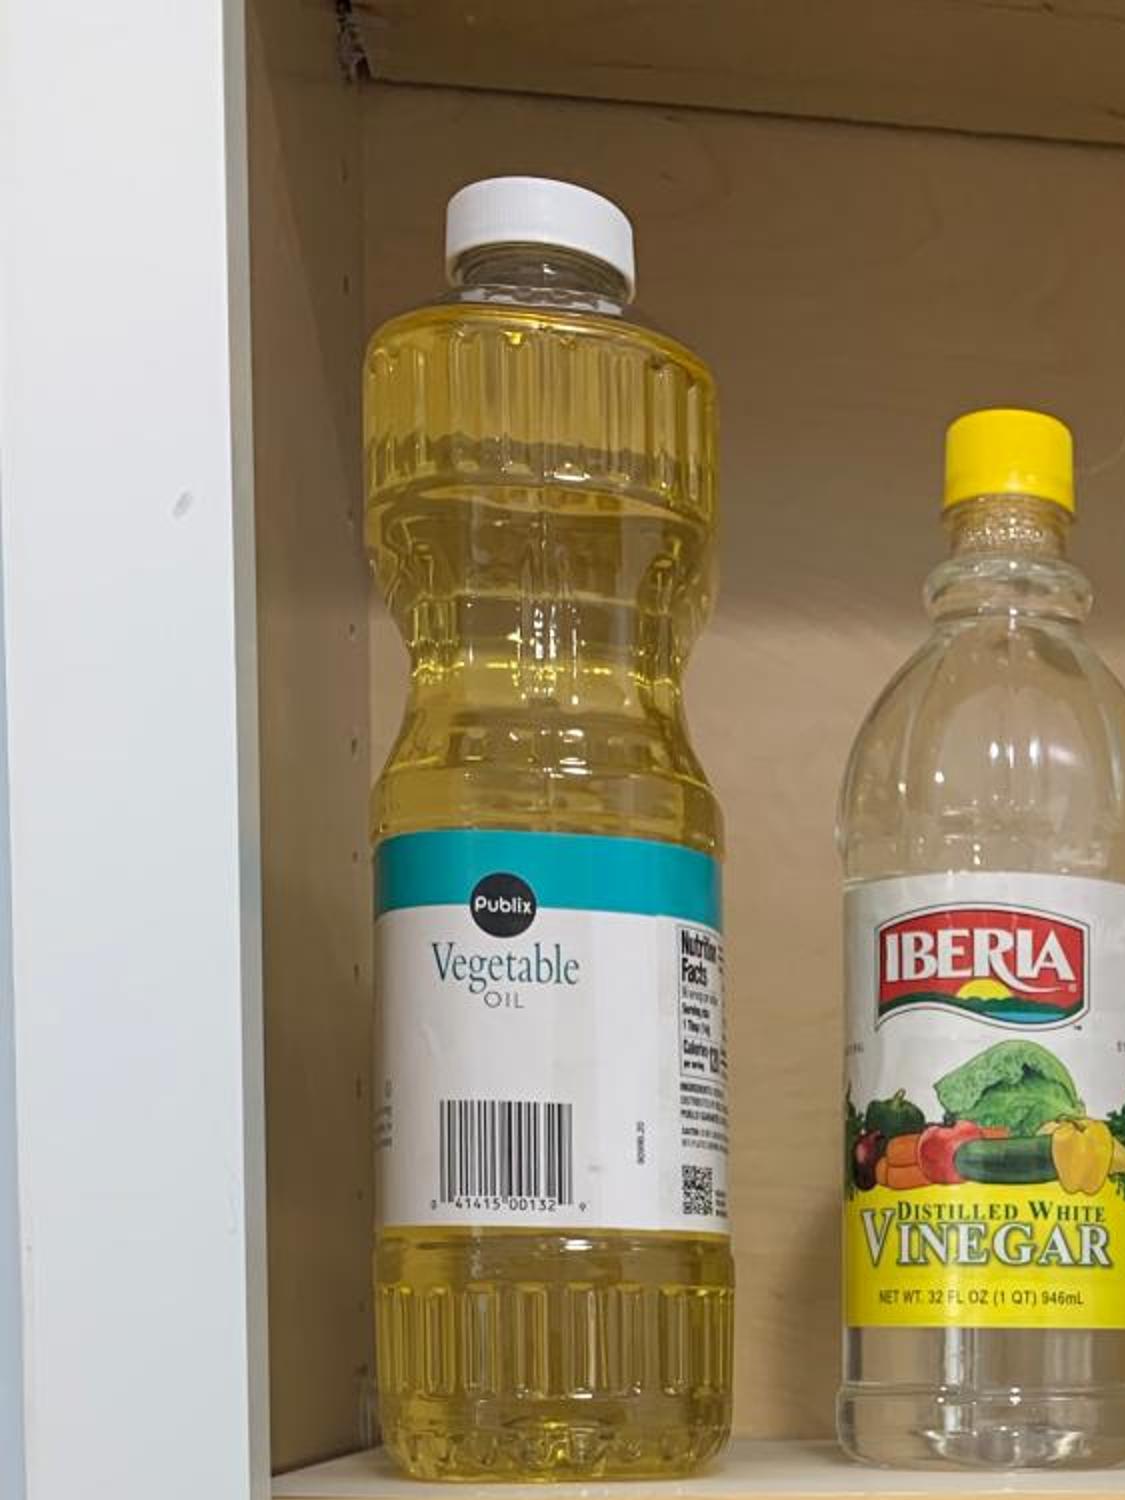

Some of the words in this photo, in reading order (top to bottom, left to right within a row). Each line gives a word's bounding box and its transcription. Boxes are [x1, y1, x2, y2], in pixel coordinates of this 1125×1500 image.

[474, 895, 532, 915] Publix
[432, 942, 579, 994] Vegetable
[885, 928, 1076, 992] IBERIA
[484, 994, 524, 1009] OIL
[456, 1198, 501, 1211] 41415
[509, 1199, 556, 1212] 00132
[897, 1201, 1018, 1222] DISTILLED
[1029, 1201, 1105, 1223] WHITE
[861, 1208, 1114, 1268] VINEGAR
[879, 1289, 900, 1305] NET
[928, 1289, 944, 1305] 32
[947, 1289, 964, 1305] FL
[968, 1289, 988, 1305] OZ
[993, 1289, 1005, 1308] (1
[1011, 1289, 1037, 1308] QT)
[1042, 1290, 1085, 1306] 946mL
